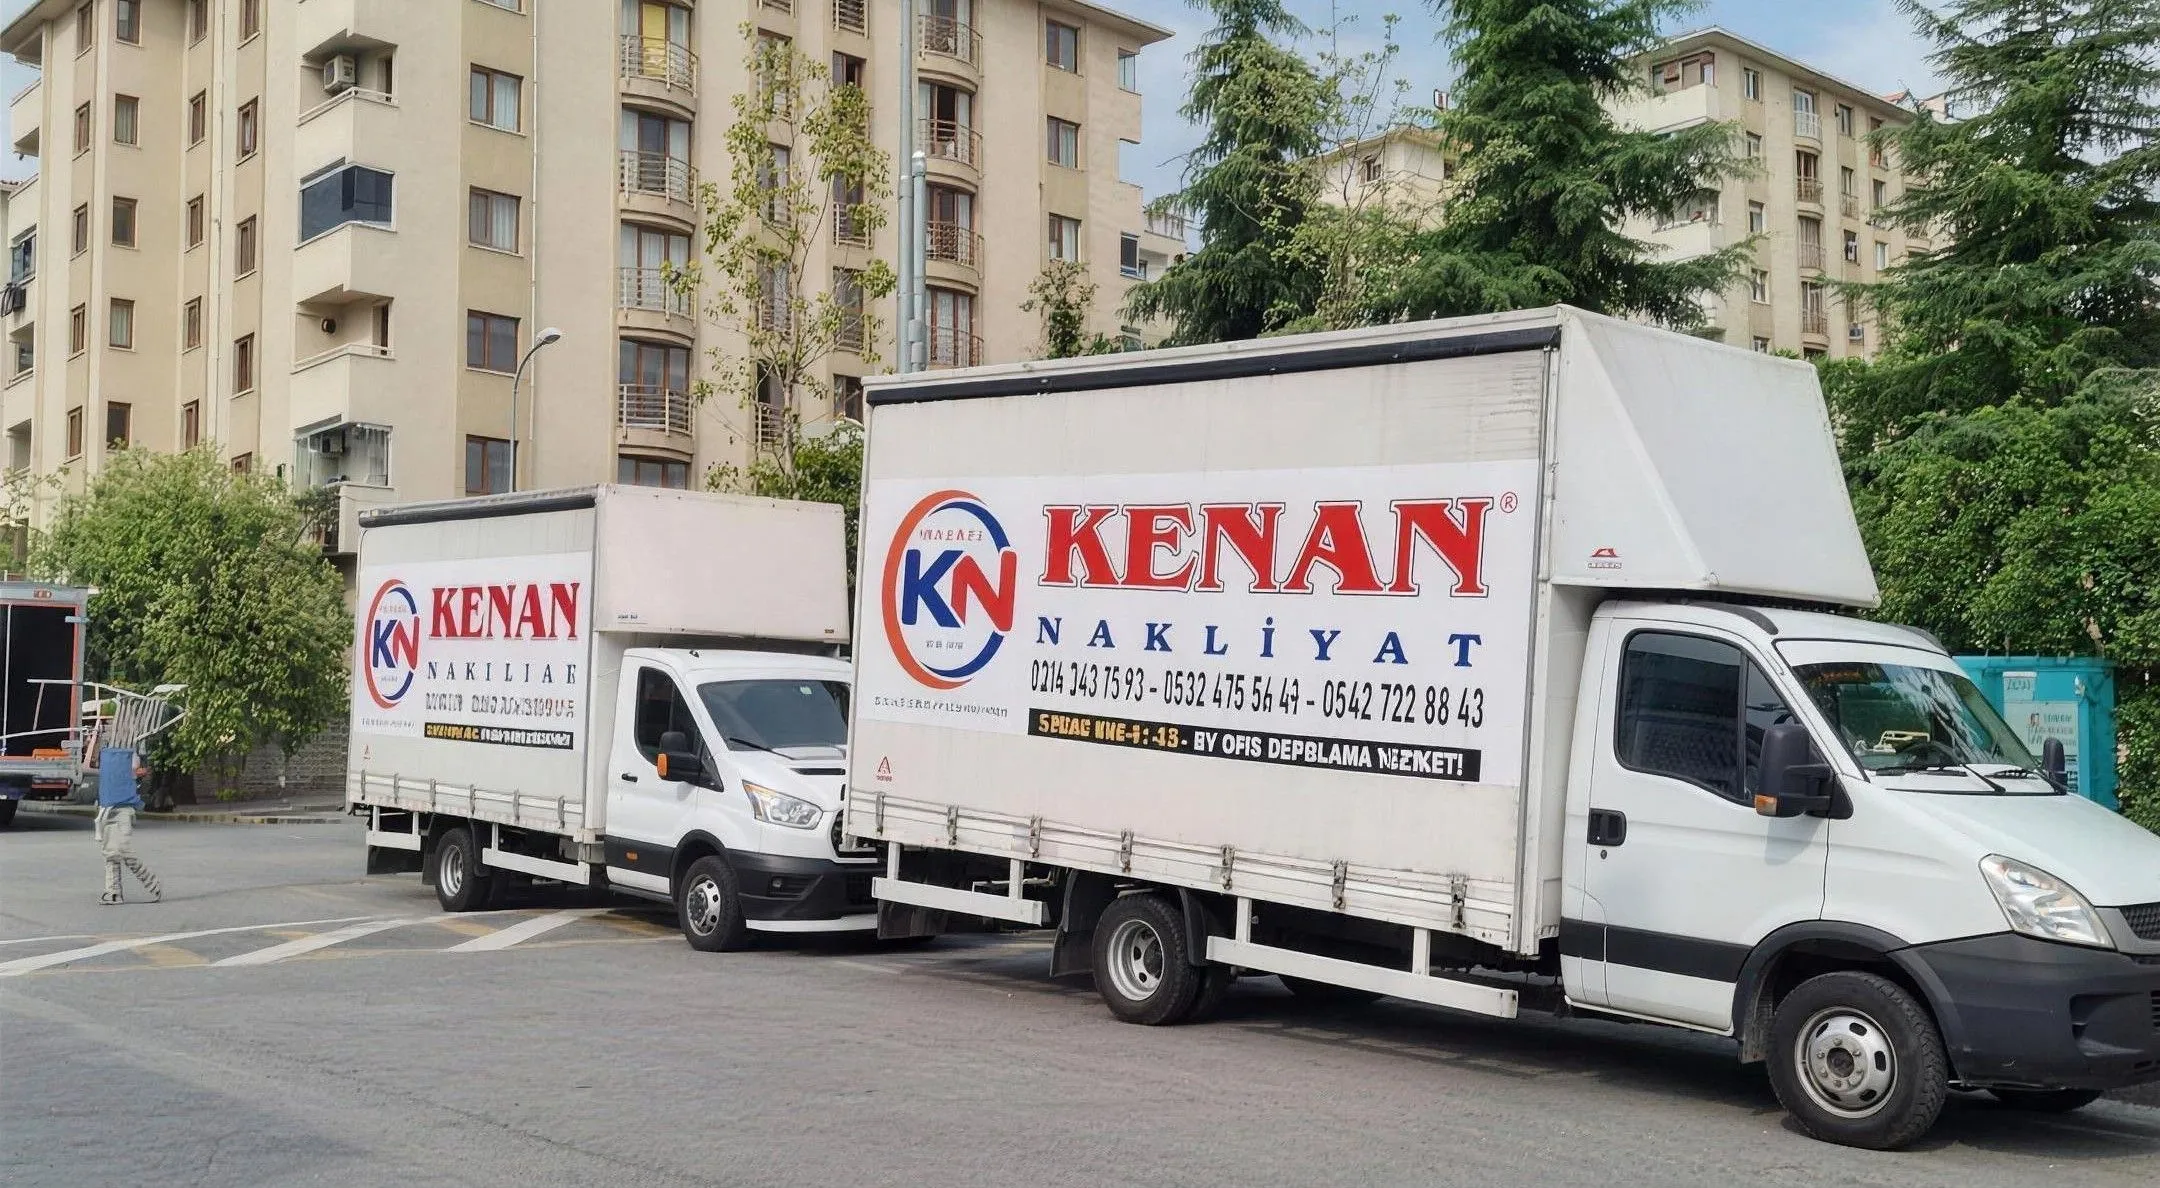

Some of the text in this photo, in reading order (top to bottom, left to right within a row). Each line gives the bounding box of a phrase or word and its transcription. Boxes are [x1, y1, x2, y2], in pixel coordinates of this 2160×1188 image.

[1038, 497, 1494, 598] KENAN
[428, 582, 580, 641] KENAN
[901, 548, 1017, 632] KN
[372, 616, 420, 671] KN
[1037, 616, 1482, 667] NAKLİYAT
[1164, 670, 1206, 707] 0532
[1212, 672, 1245, 711] 475
[1323, 680, 1373, 721] 0542
[1380, 683, 1416, 723] 722
[1424, 685, 1449, 726] 88
[1457, 687, 1484, 729] 43
